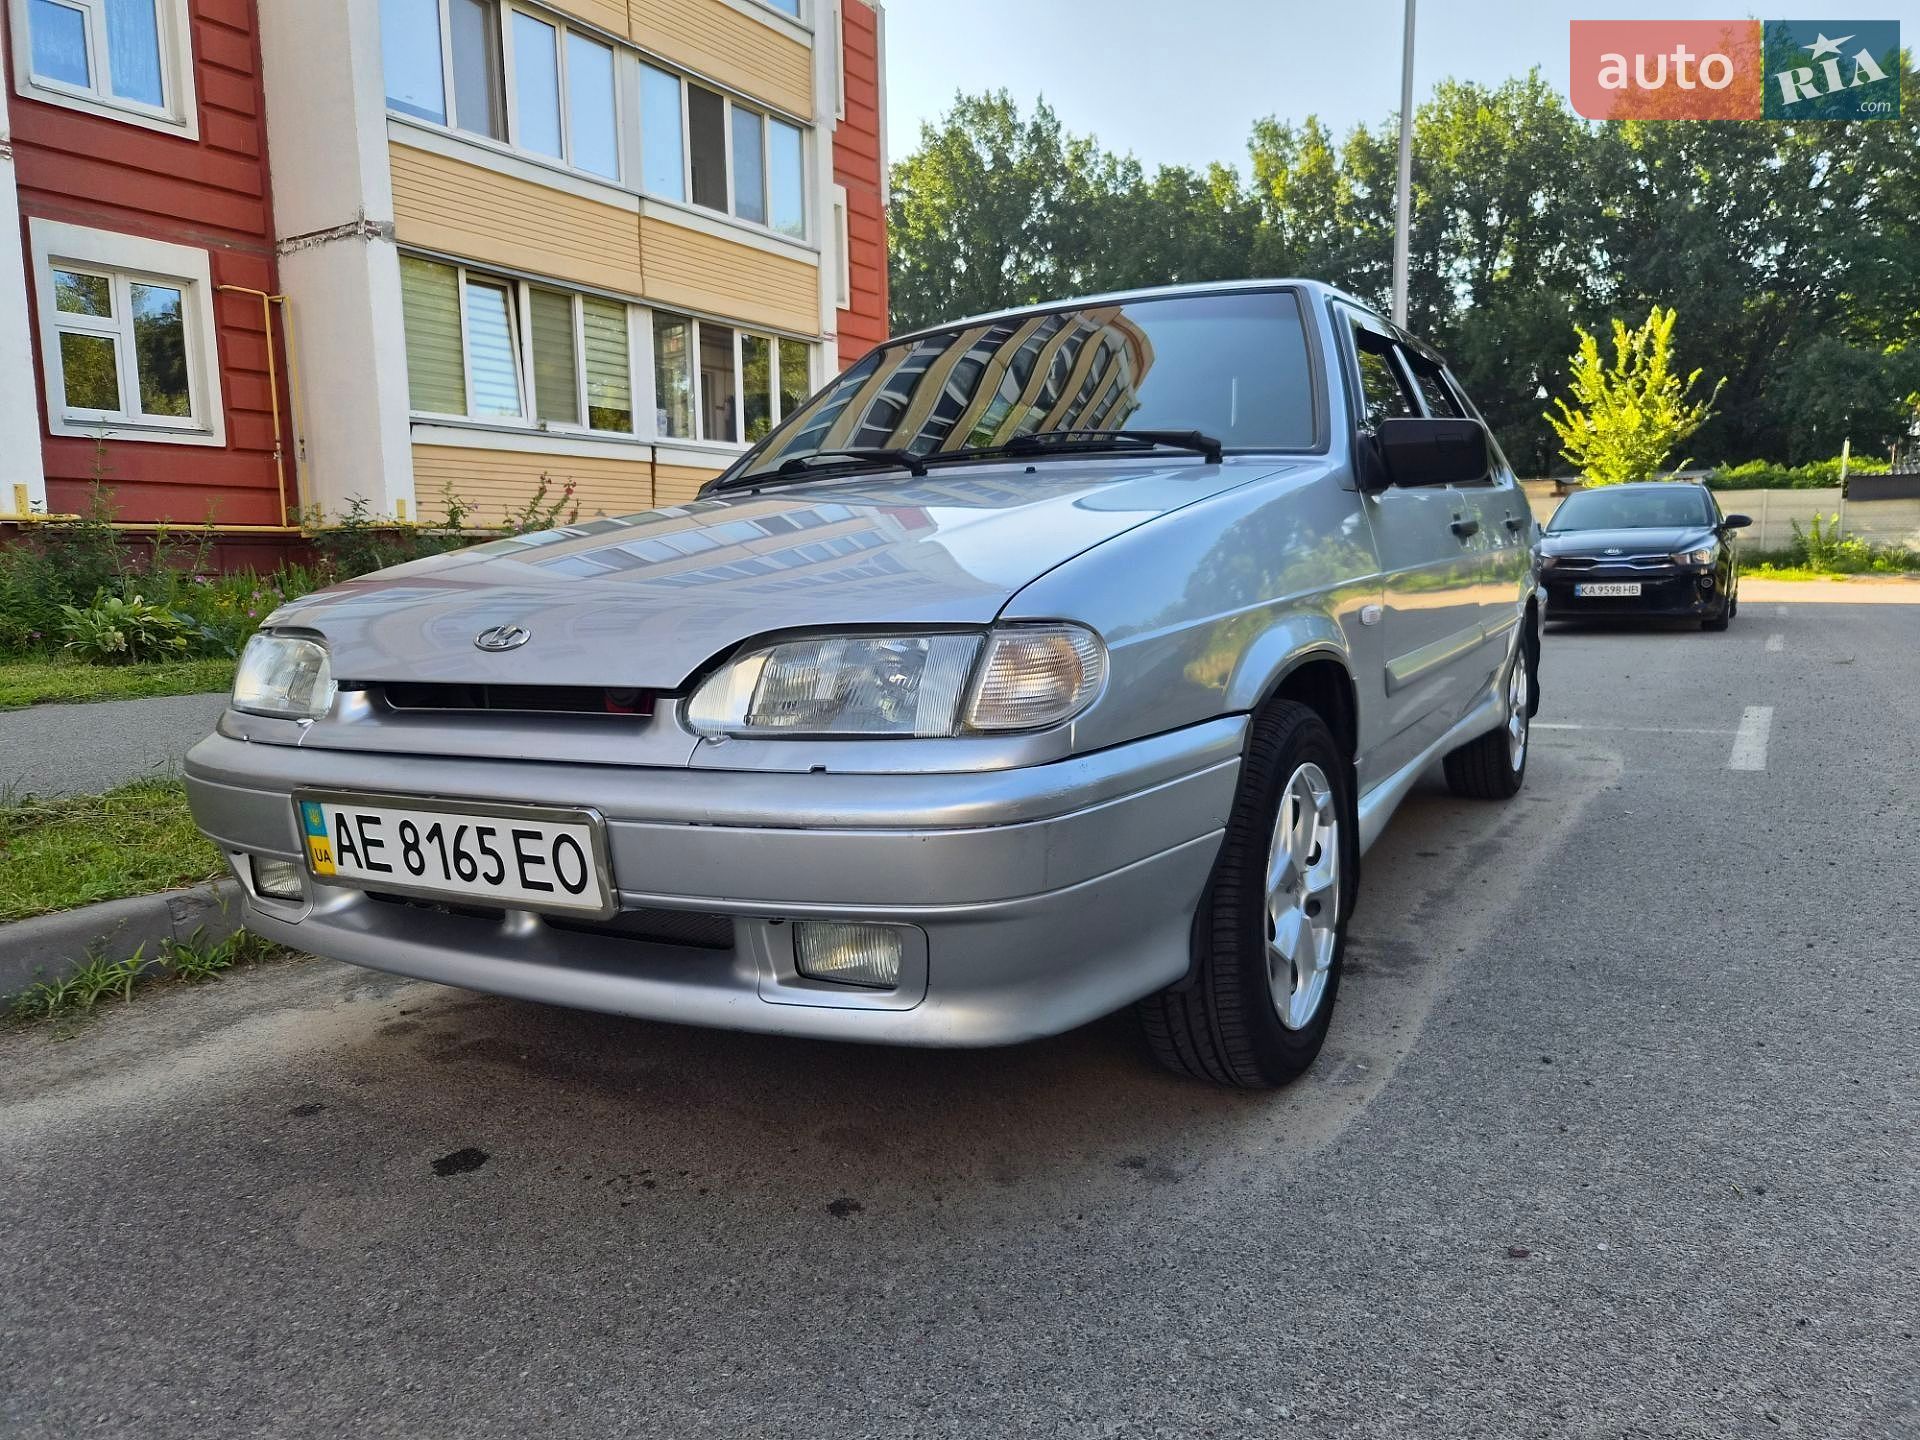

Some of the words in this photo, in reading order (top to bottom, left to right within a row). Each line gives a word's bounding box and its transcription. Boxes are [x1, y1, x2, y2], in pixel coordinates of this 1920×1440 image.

[1581, 585, 1595, 594] KA
[1597, 585, 1621, 594] 9598
[314, 848, 332, 863] UA
[335, 812, 393, 873] AE
[399, 819, 505, 885] 8165
[511, 829, 588, 895] EO
